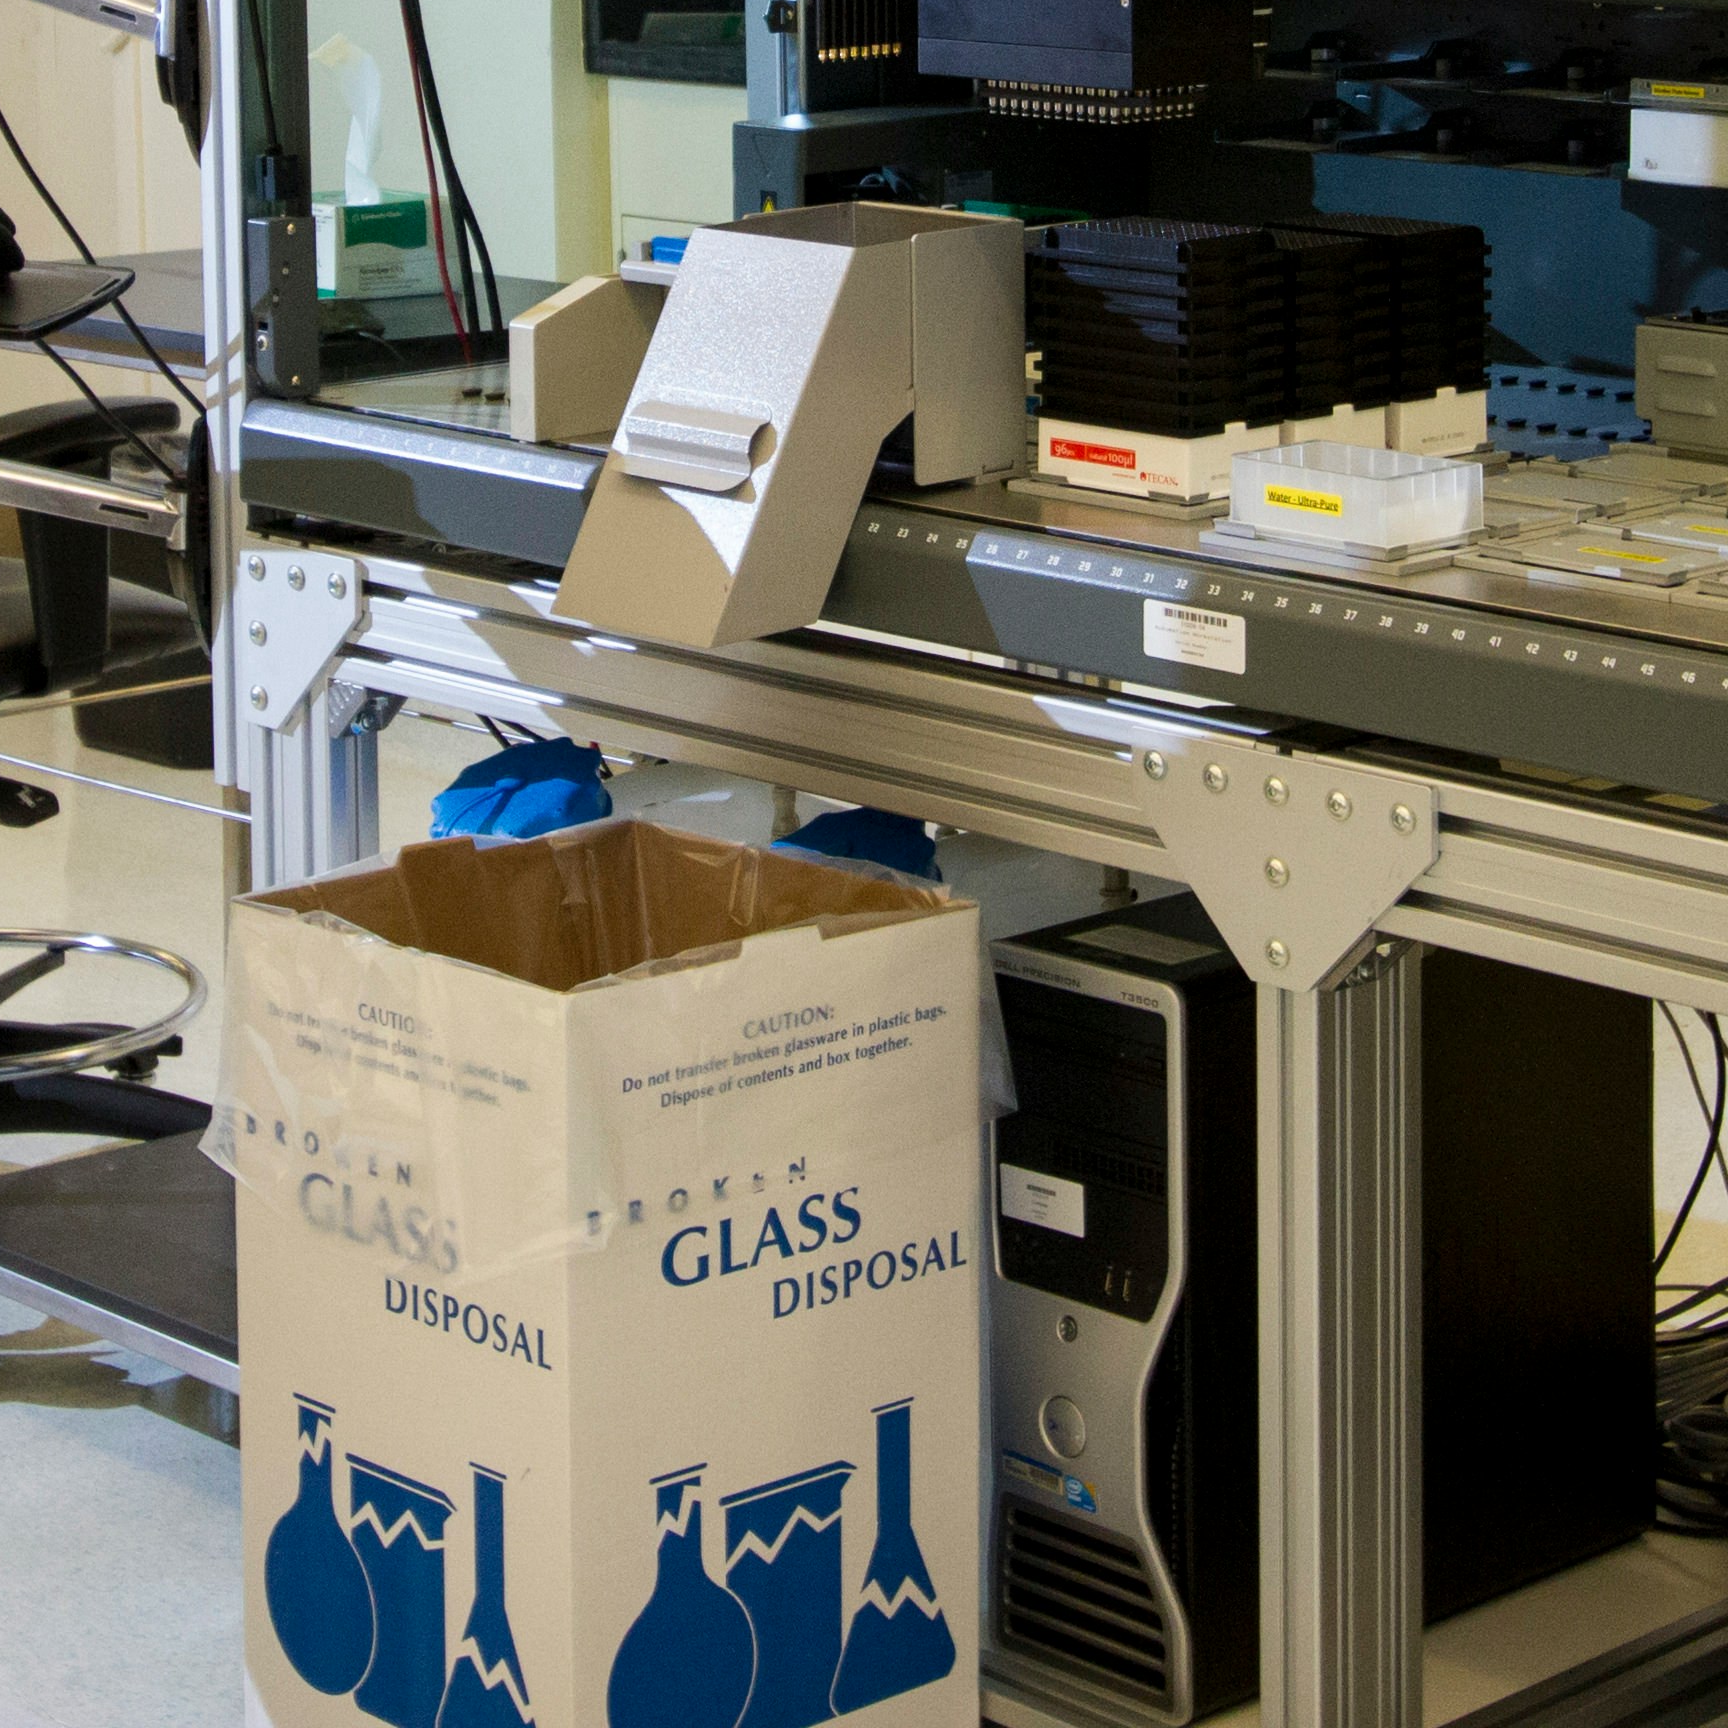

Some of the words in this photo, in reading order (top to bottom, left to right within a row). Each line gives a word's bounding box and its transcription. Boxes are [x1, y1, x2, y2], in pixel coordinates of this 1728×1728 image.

[1267, 490, 1291, 505] Water
[1297, 495, 1339, 512] Ultra-Pure
[868, 523, 879, 533] 22
[897, 528, 909, 538] 23
[926, 533, 939, 543] 24
[956, 538, 968, 549] 25
[1078, 560, 1091, 572] 29
[1110, 566, 1122, 578] 30
[1143, 572, 1154, 584] 31
[1175, 578, 1188, 590] 32
[1207, 584, 1220, 596] 33
[1241, 590, 1254, 603] 34
[1274, 596, 1288, 609] 35
[1309, 602, 1322, 615] 36
[1344, 609, 1358, 622] 37
[1379, 615, 1393, 628] 38
[1414, 622, 1429, 635] 39
[1451, 628, 1465, 641] 40
[1489, 635, 1502, 648] 41
[1525, 642, 1540, 655] 42
[1563, 649, 1578, 662] 43
[1601, 656, 1617, 669] 44
[1640, 663, 1655, 676] 45
[1681, 670, 1696, 684] 46
[995, 959, 1019, 972] DELL
[1023, 966, 1081, 989] PRECISION
[1120, 991, 1159, 1009] T3500
[622, 1077, 643, 1094] Do
[648, 1071, 672, 1087] not
[675, 1055, 729, 1081] transfer
[733, 1044, 780, 1067] broken
[784, 1027, 848, 1057] glassware
[852, 1023, 865, 1037] in
[868, 1011, 911, 1038] plastic
[915, 1004, 948, 1023] bags.
[743, 1004, 835, 1040] CAUTION:
[660, 1084, 715, 1109] Dispose
[718, 1079, 733, 1095] of
[737, 1065, 795, 1089] contents
[798, 1054, 823, 1073] and
[826, 1051, 851, 1067] box
[855, 1034, 913, 1060] together.
[298, 1172, 459, 1274] GLASS
[660, 1186, 862, 1287] GLASS
[773, 1230, 968, 1319] DISPOSAL
[384, 1276, 553, 1371] DISPOSAL
